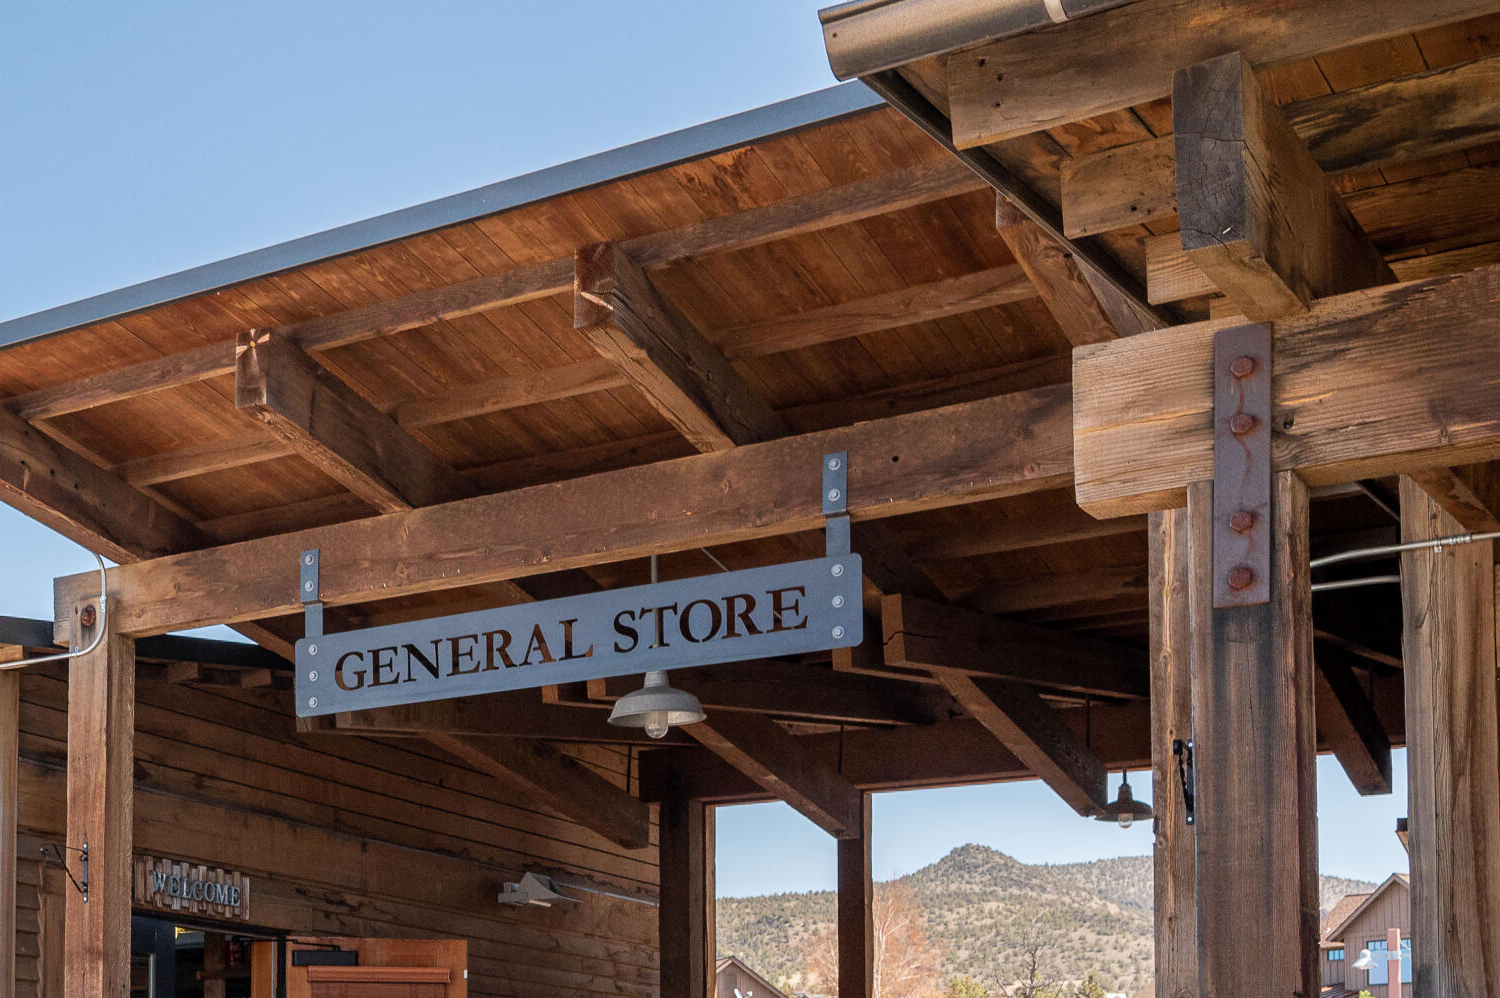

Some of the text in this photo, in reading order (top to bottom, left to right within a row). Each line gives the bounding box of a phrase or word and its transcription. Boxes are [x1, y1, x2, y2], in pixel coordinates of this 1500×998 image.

[334, 586, 808, 691] GENERAL STORE
[149, 869, 241, 907] WELCOME
